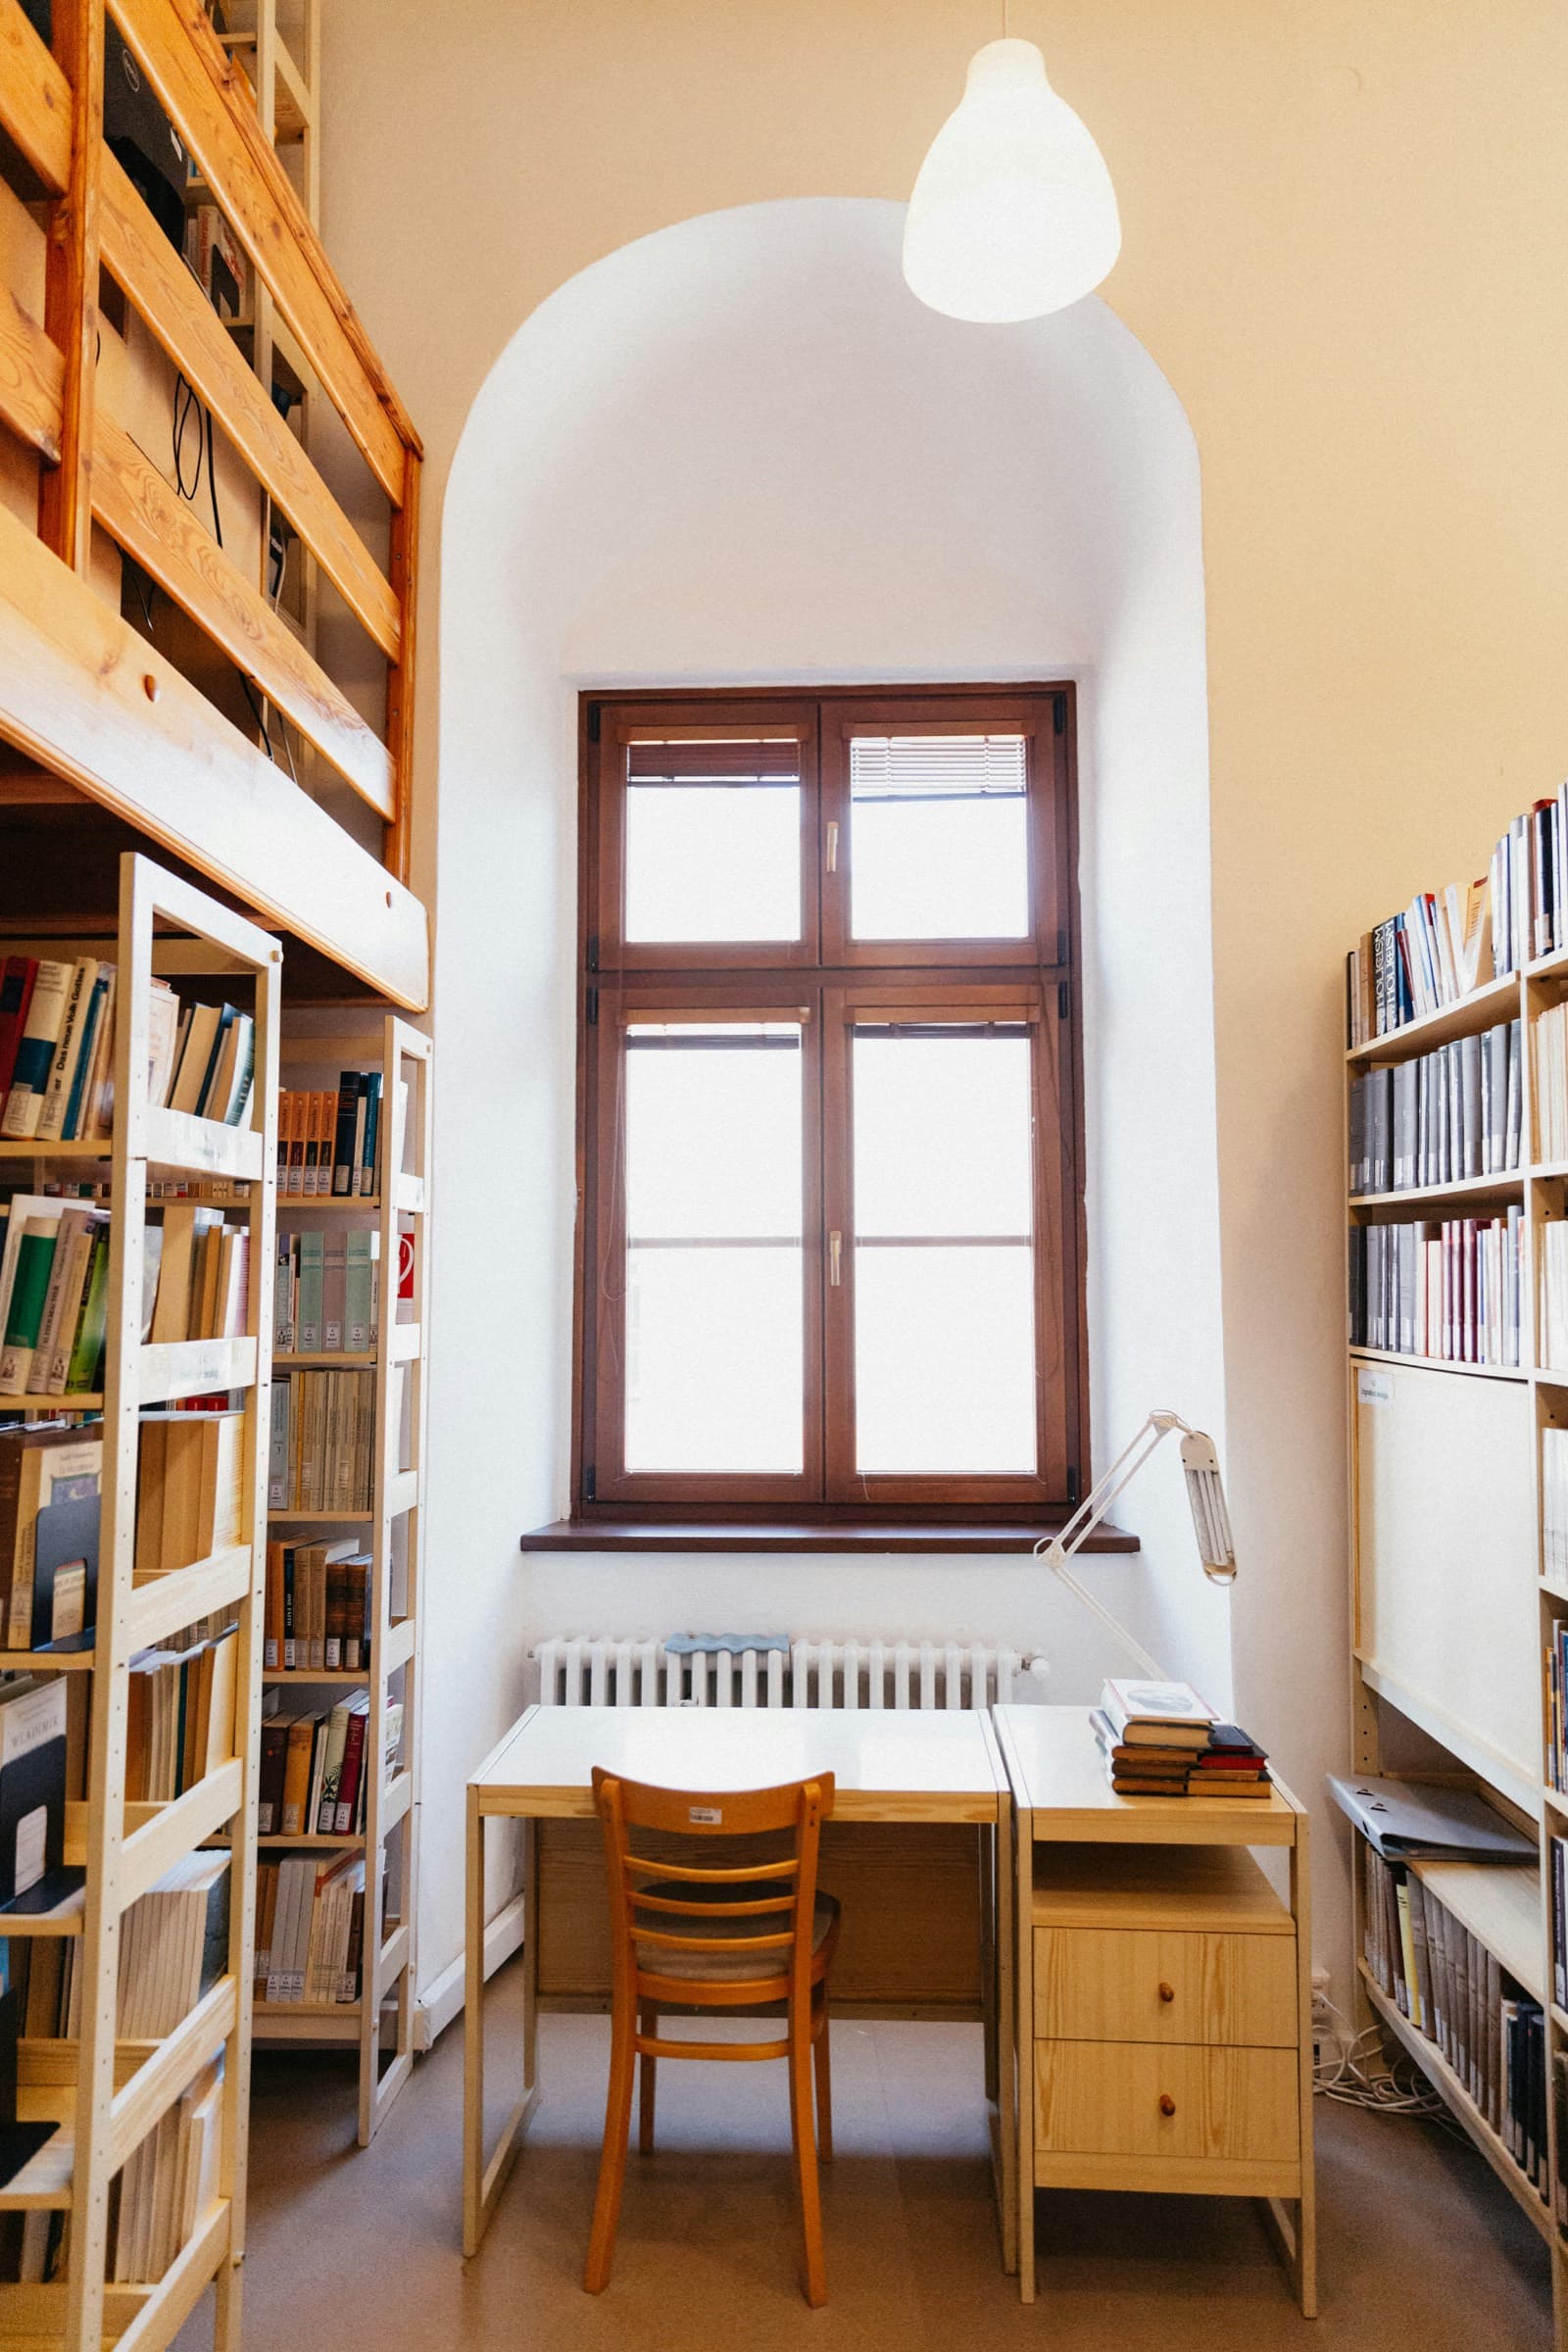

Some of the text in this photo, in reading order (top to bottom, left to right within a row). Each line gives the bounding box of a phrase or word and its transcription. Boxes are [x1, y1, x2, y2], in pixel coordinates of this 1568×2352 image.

[71, 966, 85, 1001] Gottes
[66, 1001, 78, 1024] Volk
[62, 1024, 74, 1050] neue
[56, 1049, 68, 1071] Das
